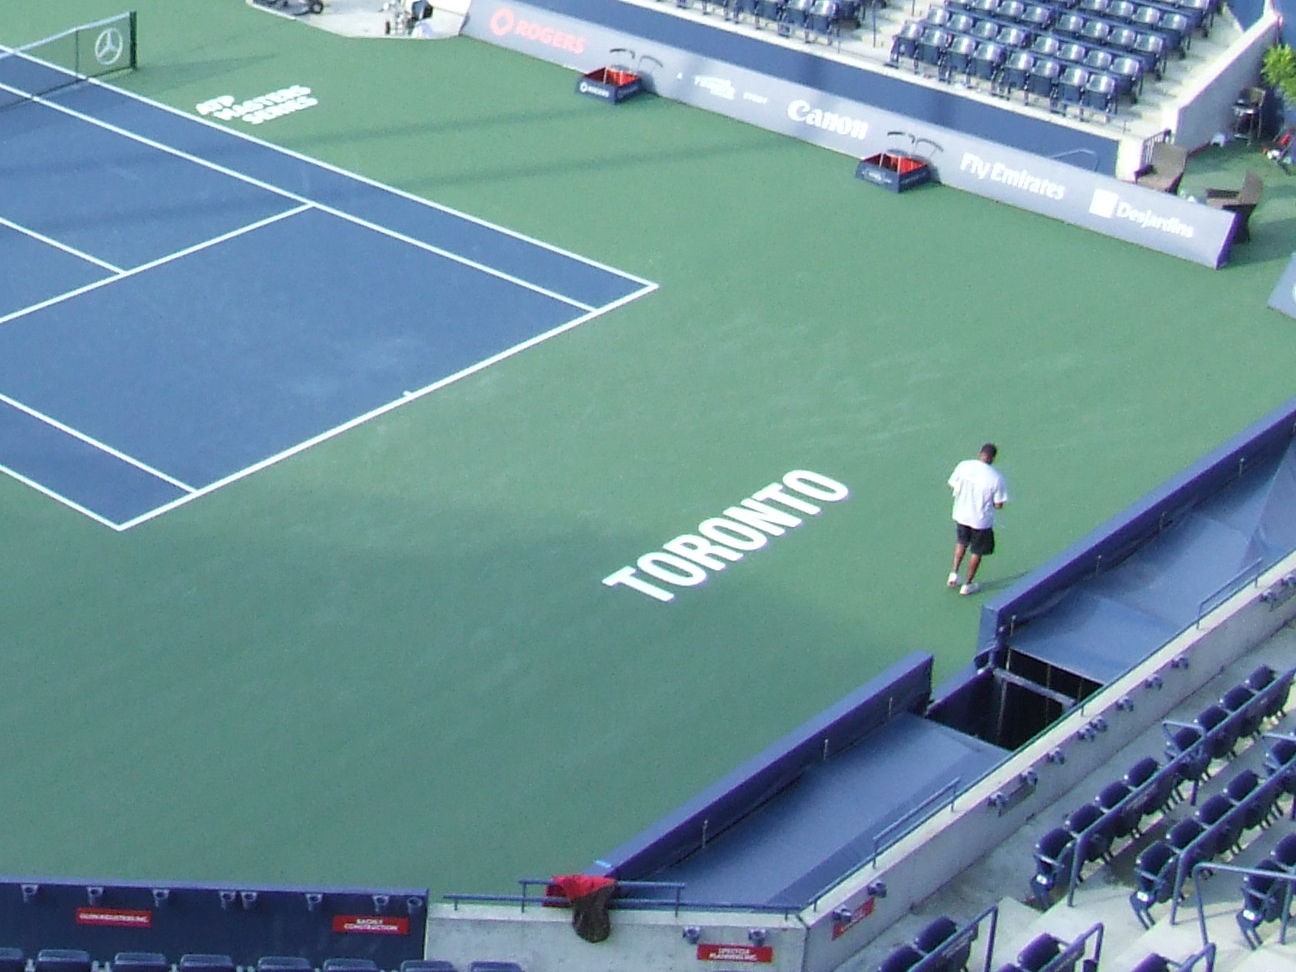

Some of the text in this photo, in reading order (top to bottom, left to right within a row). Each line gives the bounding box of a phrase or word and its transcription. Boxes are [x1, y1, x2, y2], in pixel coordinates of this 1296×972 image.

[515, 19, 586, 55] ROGERS
[787, 99, 869, 140] Canon
[960, 152, 1067, 201] Fly Emirates
[1116, 201, 1196, 239] Desjardins
[601, 468, 851, 603] TORONTO
